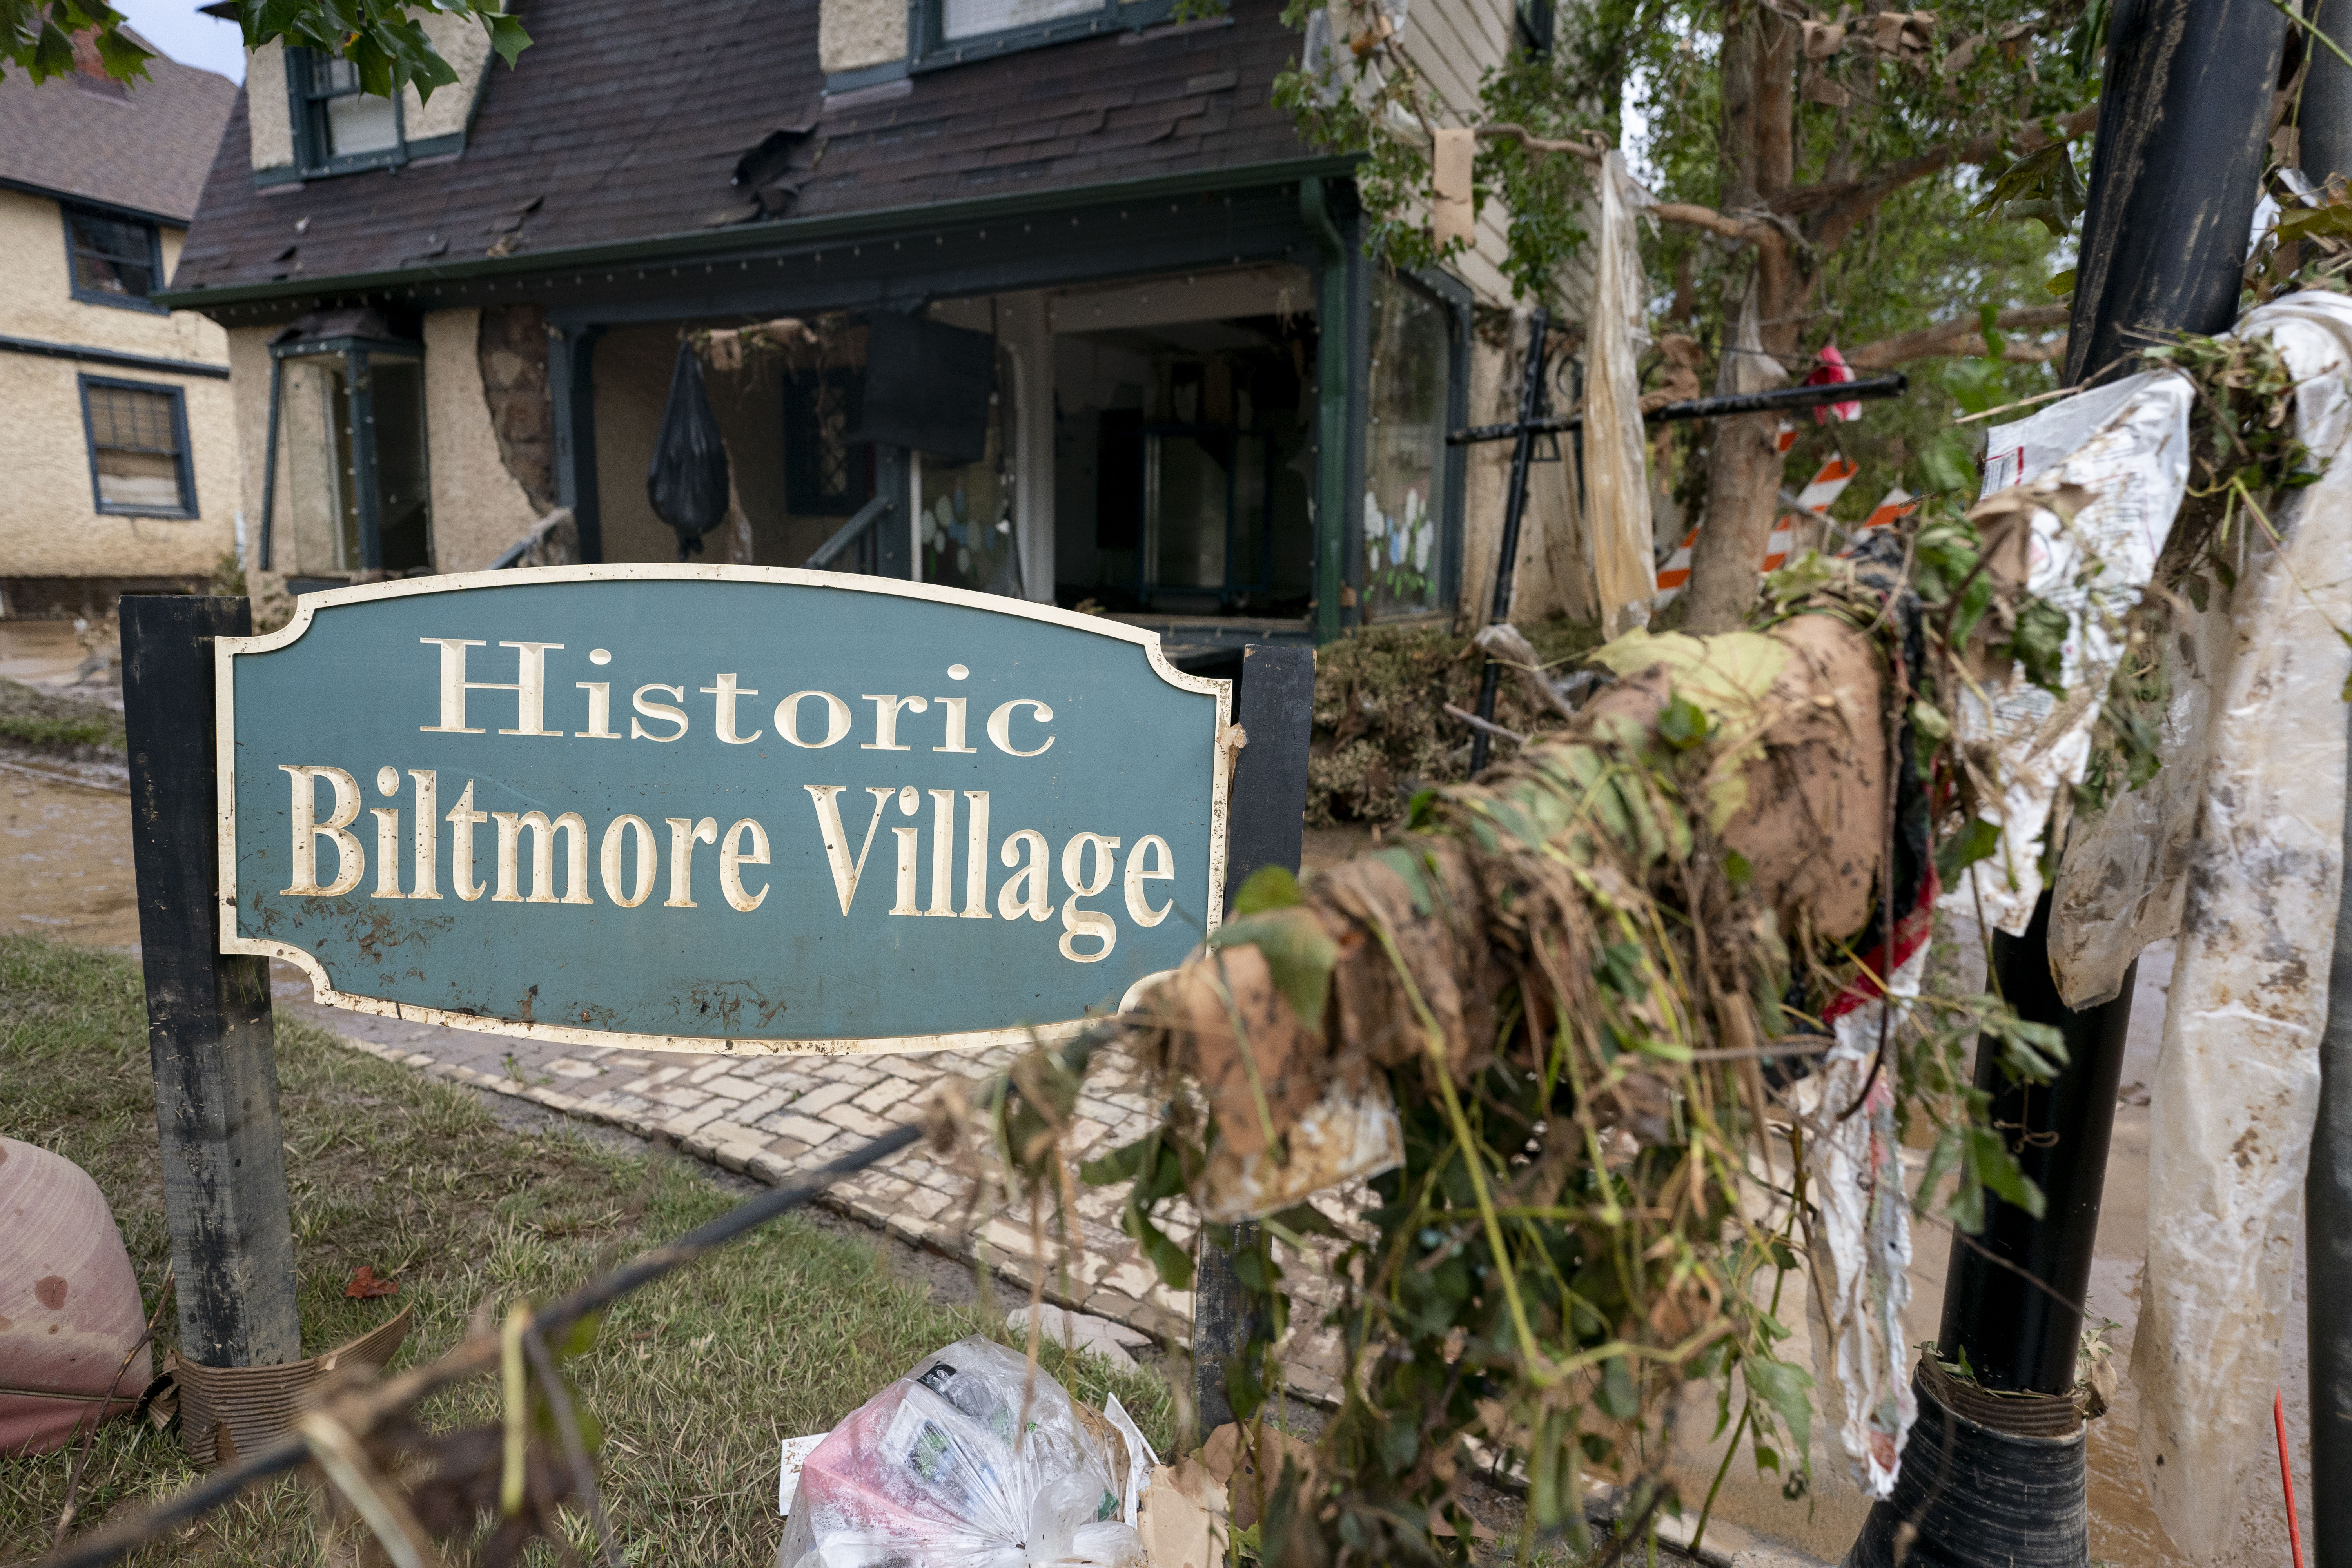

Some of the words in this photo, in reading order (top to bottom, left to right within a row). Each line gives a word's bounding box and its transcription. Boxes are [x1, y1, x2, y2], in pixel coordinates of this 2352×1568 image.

[419, 637, 1056, 757] Historic
[278, 764, 771, 913] Biltmore
[804, 784, 1175, 964] Village
